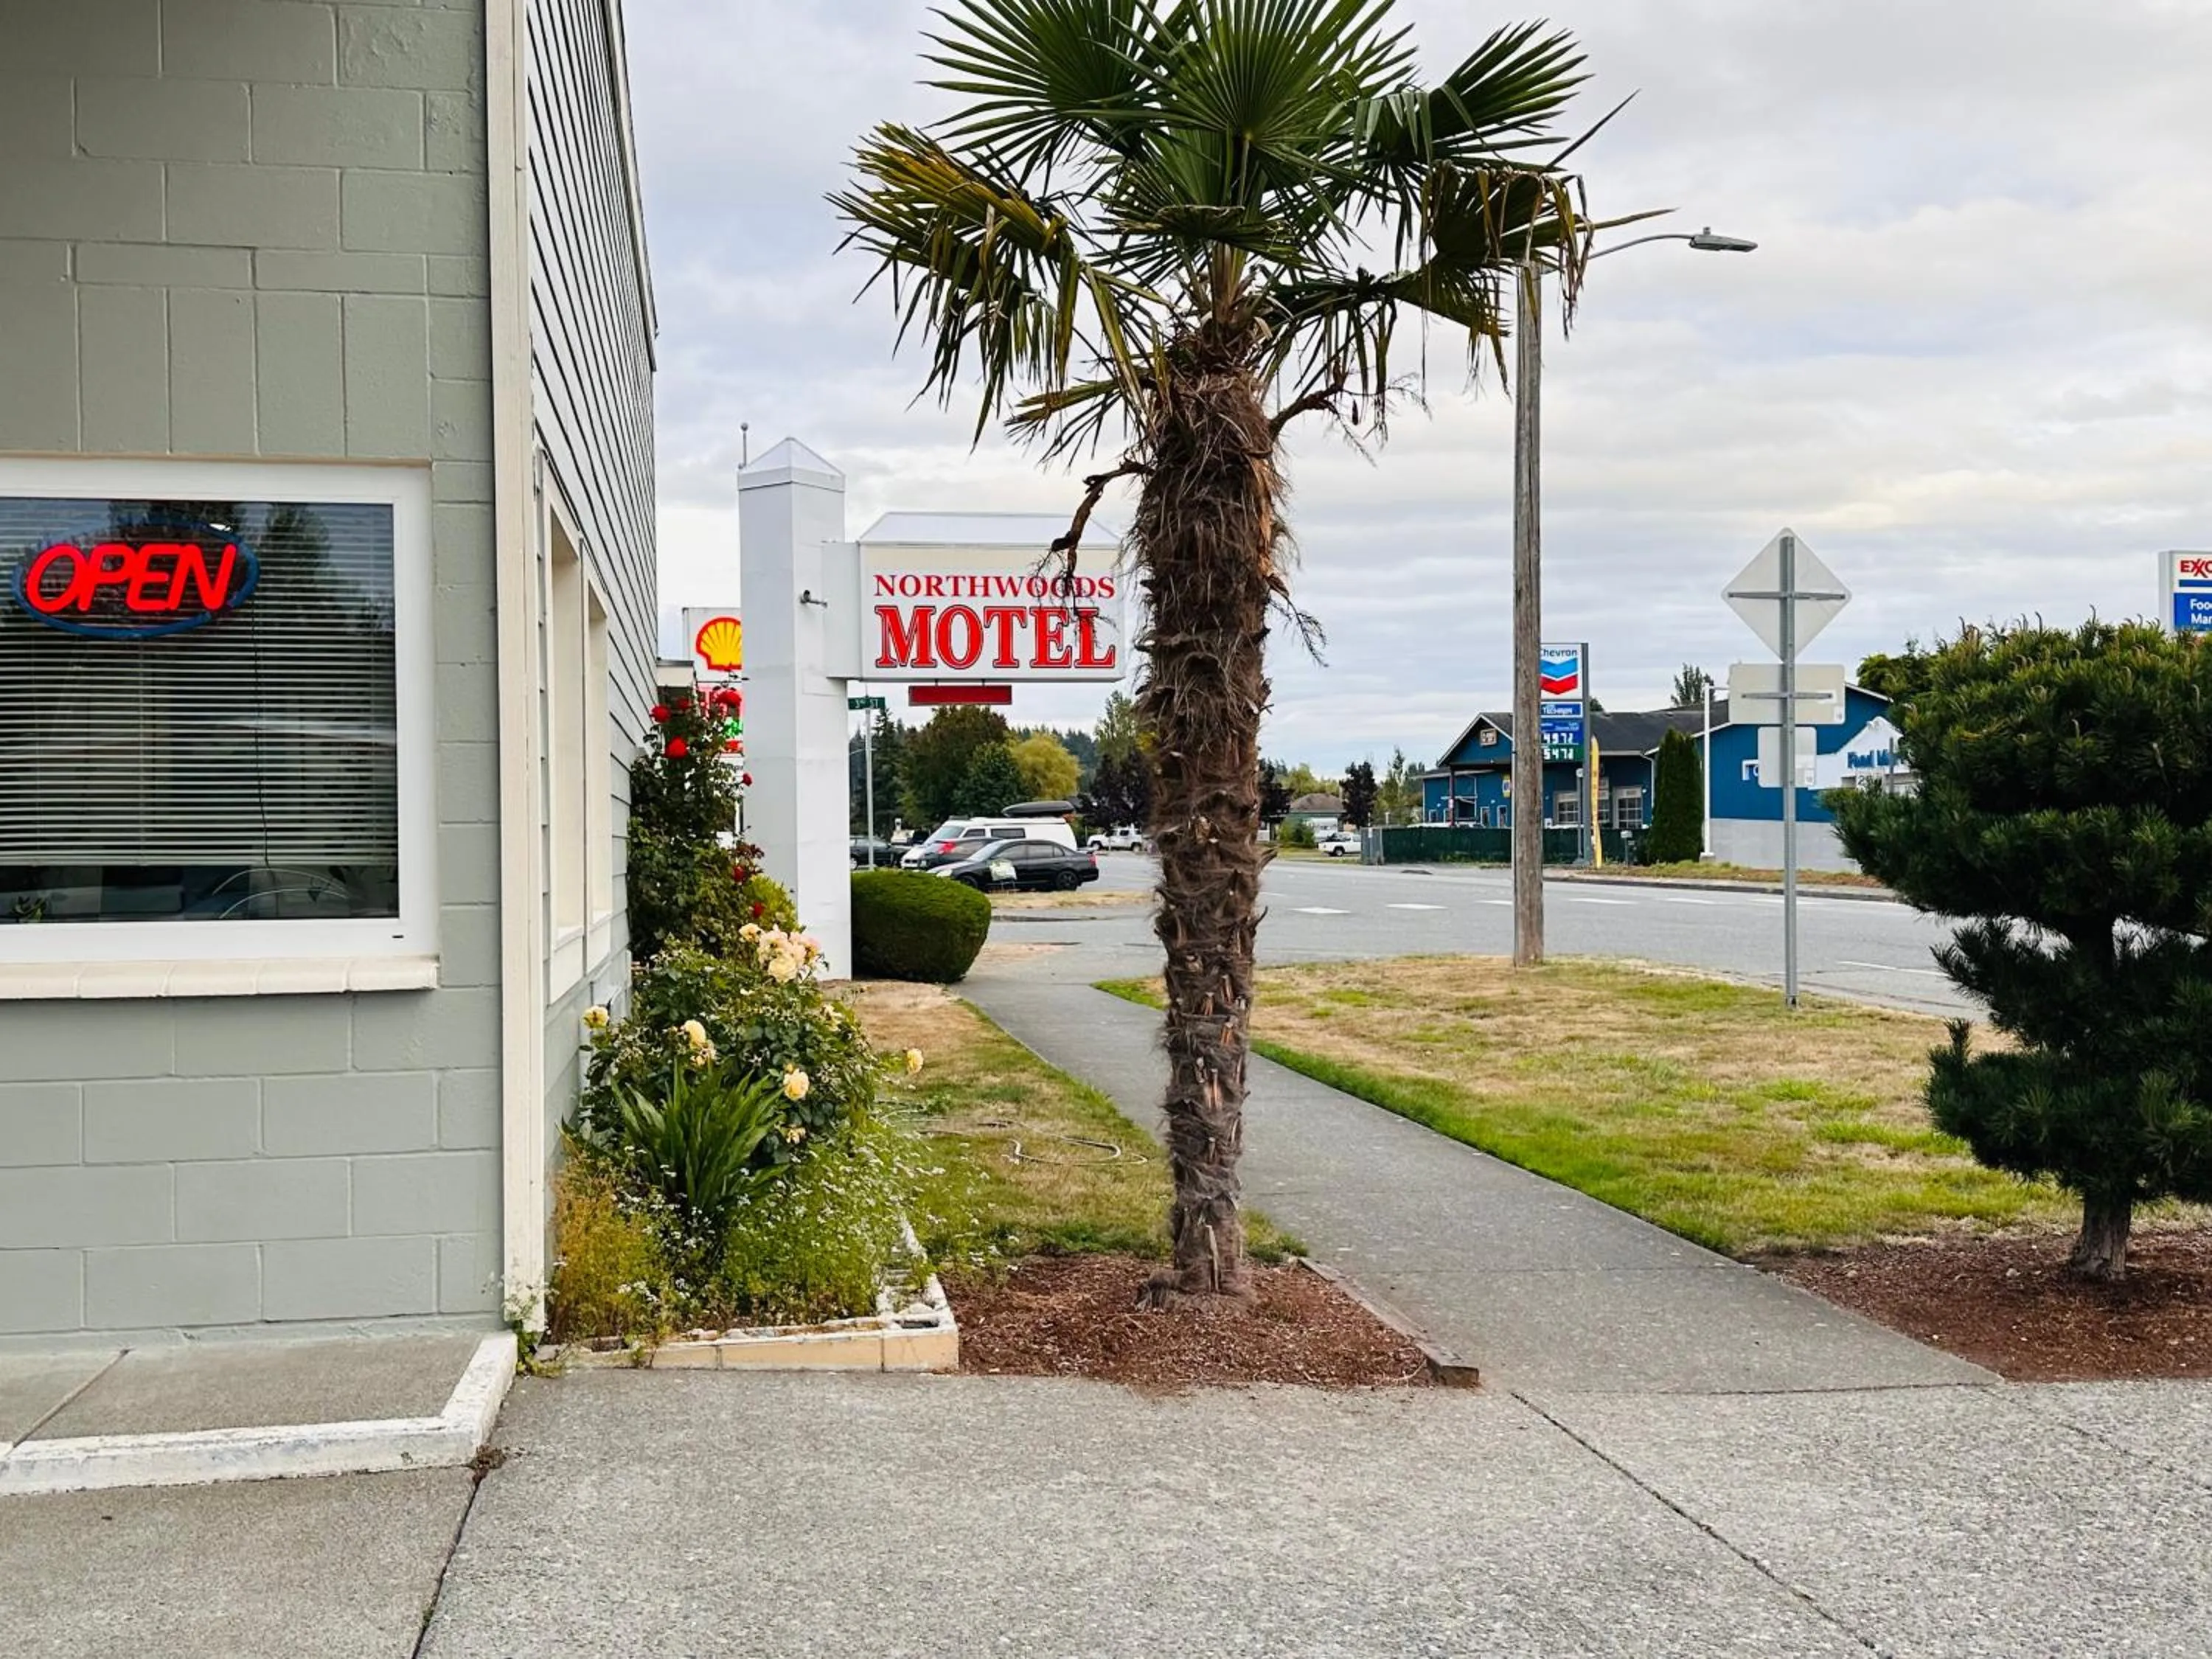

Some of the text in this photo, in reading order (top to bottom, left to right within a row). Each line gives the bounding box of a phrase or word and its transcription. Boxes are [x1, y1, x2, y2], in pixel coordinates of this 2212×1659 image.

[27, 543, 237, 613] OPEN
[873, 574, 1115, 598] NORTHWOODS
[2190, 599, 2212, 611] Foo
[874, 604, 1116, 669] MOTEL
[1541, 648, 1578, 656] hevron
